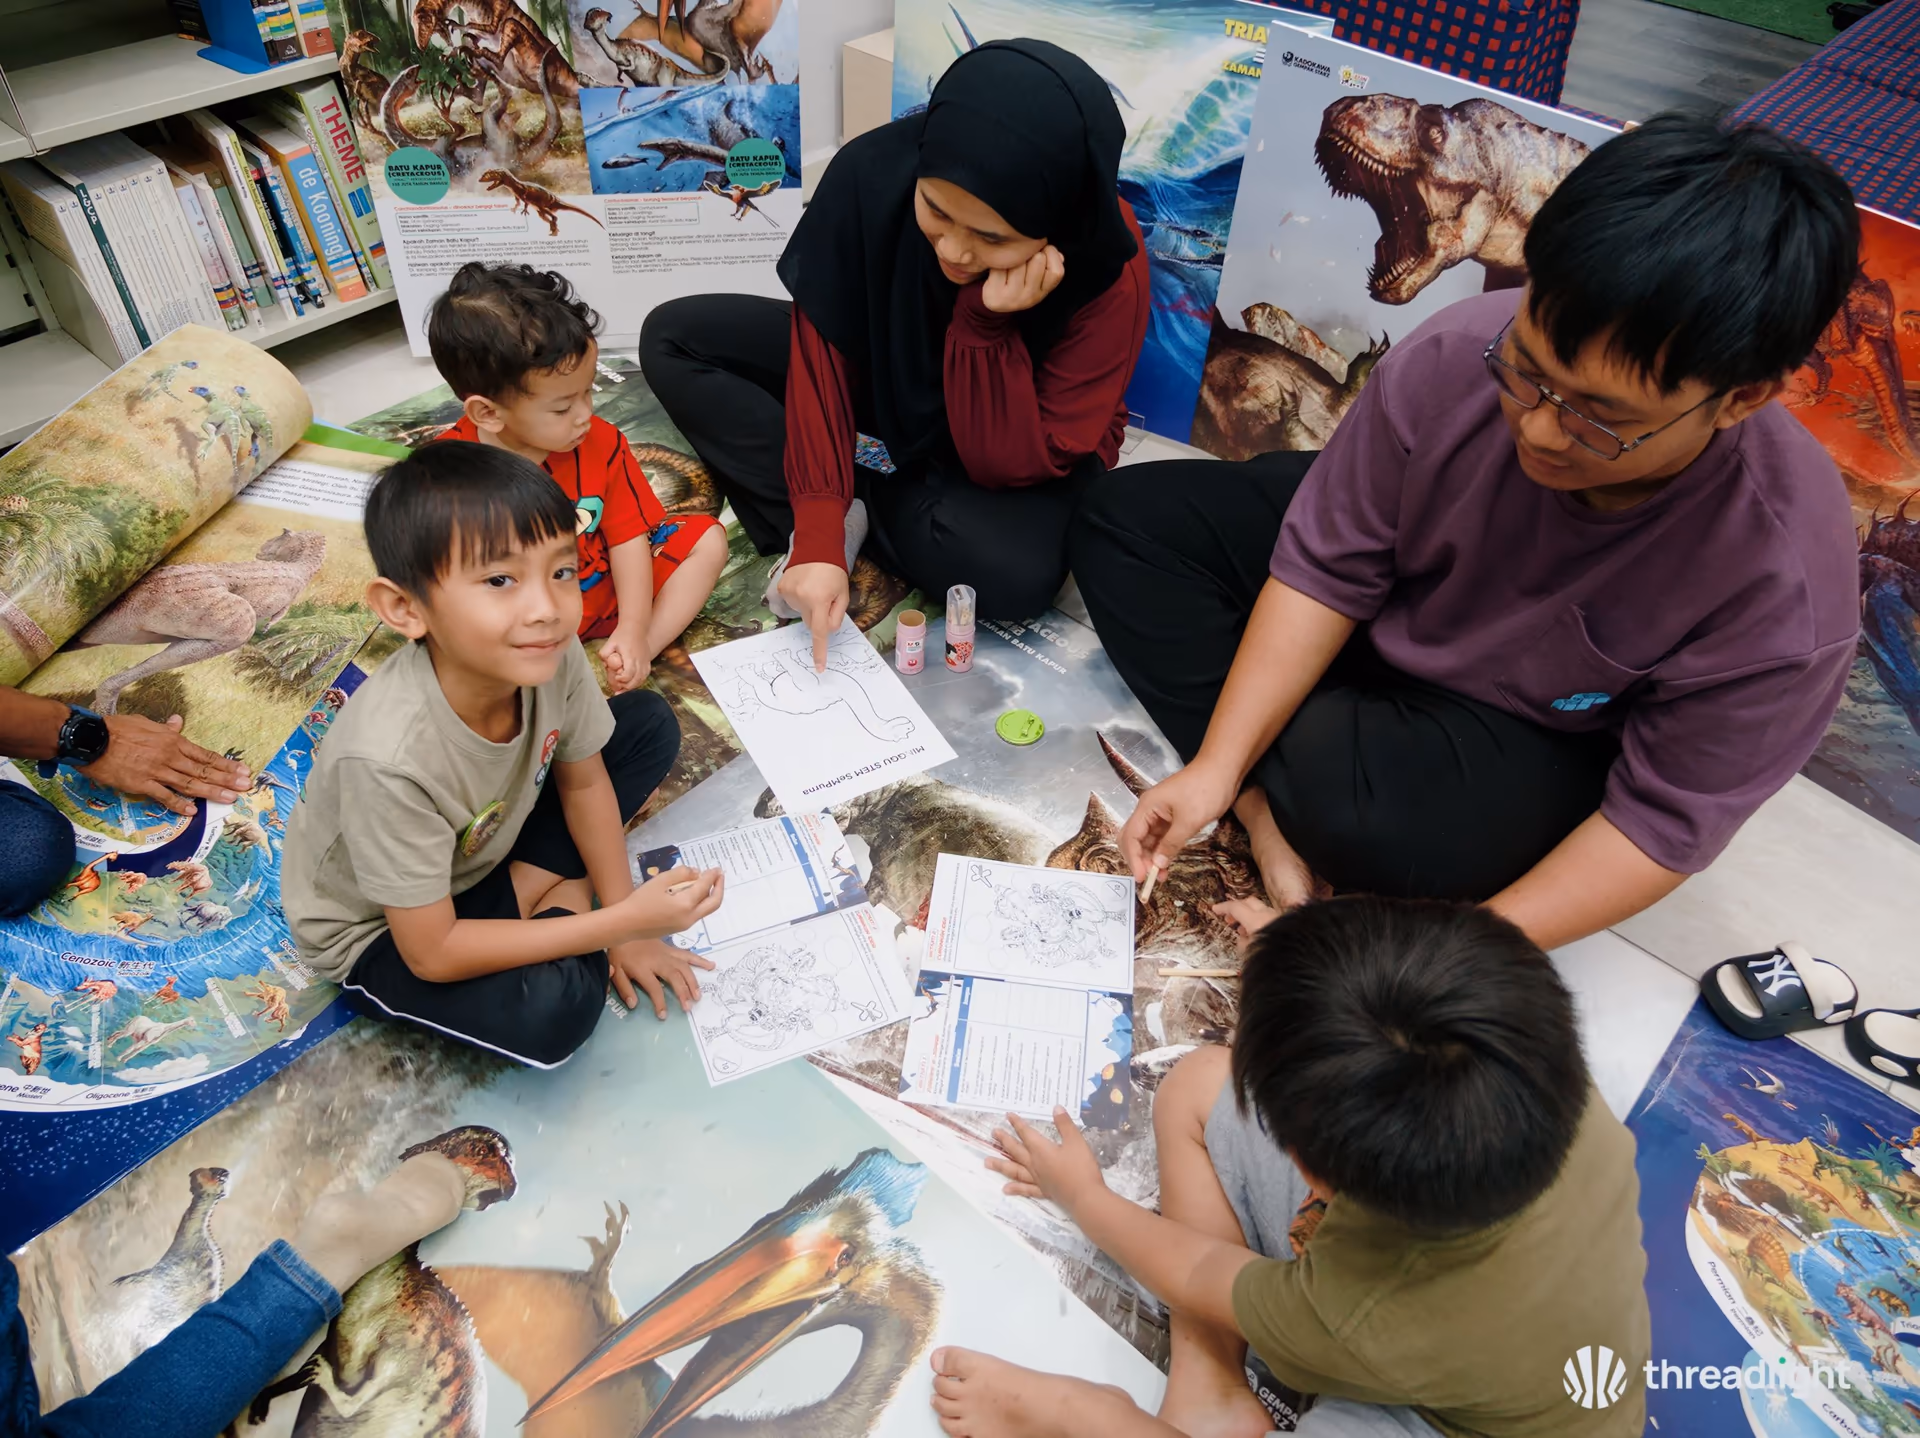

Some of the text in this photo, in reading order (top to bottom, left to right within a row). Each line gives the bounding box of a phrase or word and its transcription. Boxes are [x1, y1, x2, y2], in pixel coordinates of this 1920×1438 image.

[1294, 56, 1331, 73] KADOKAWA
[321, 96, 365, 183] THEME
[730, 154, 780, 163] BATU KAPUR
[388, 163, 442, 172] BATU KAPUR
[298, 167, 317, 189] de
[308, 191, 341, 258] Kooning
[977, 618, 1068, 676] ZAMAN BATU KAPUR
[854, 762, 882, 777] STEM
[802, 772, 854, 795] SeMPurna
[60, 952, 155, 970] Cenozoic 新生代
[16, 1092, 43, 1100] Miosen
[23, 1084, 51, 1095] 中新世
[86, 1091, 130, 1100] Oligocene
[1707, 1261, 1736, 1304] Permian
[1730, 1308, 1756, 1339] Permian
